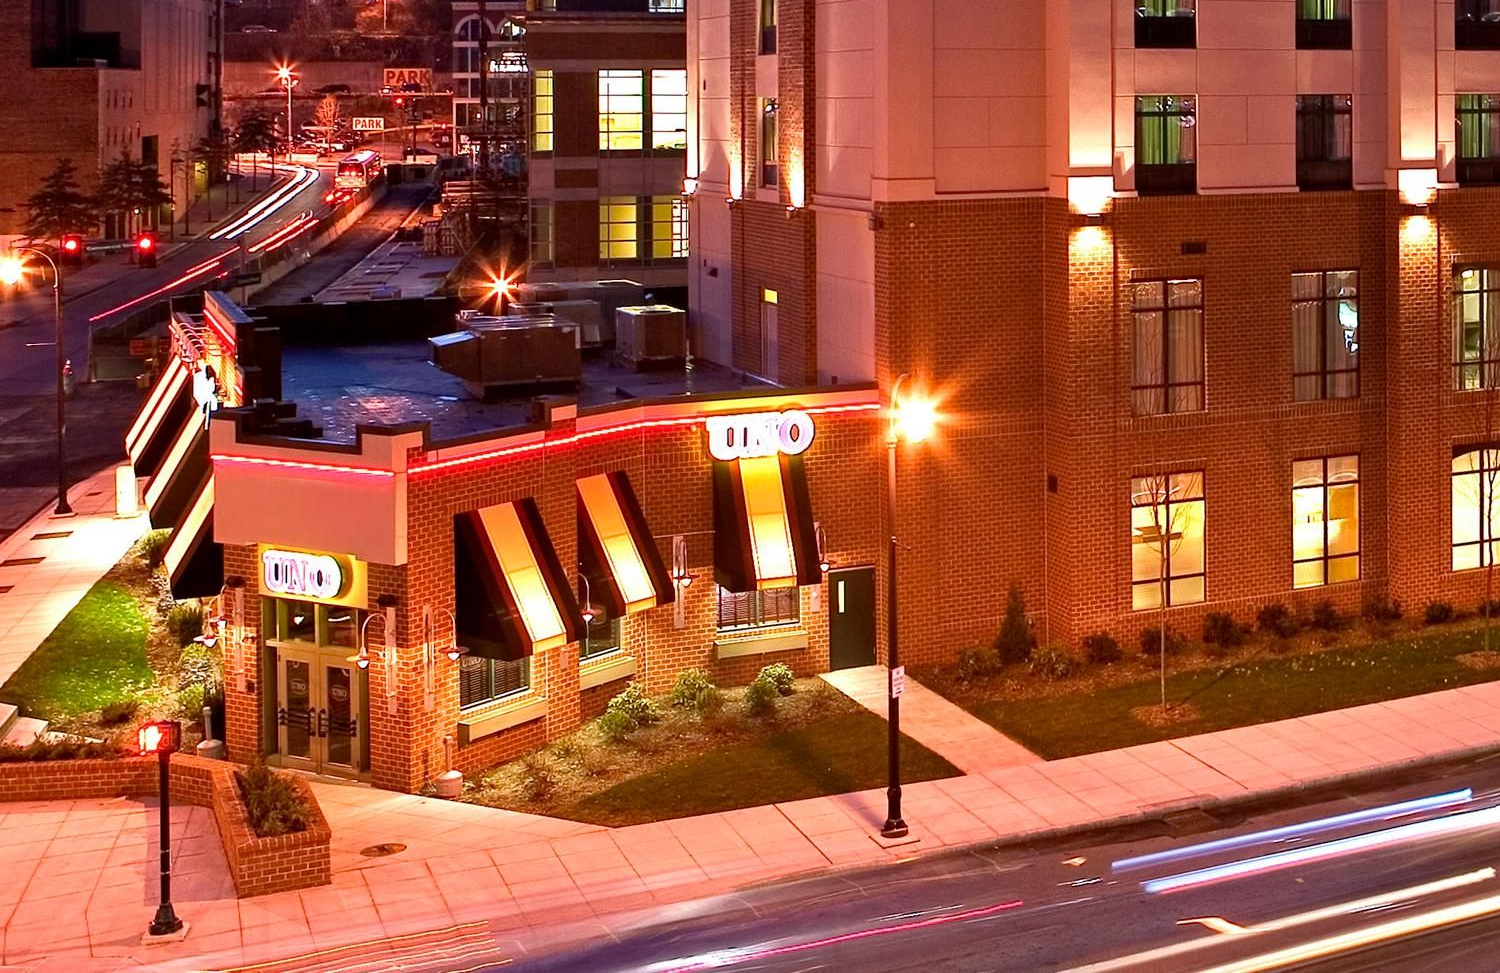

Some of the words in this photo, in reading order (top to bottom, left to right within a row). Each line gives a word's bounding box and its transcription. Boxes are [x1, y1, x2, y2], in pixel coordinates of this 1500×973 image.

[386, 69, 431, 85] PARK
[354, 118, 384, 129] PARK
[707, 411, 814, 459] UNO
[264, 552, 339, 595] UNO
